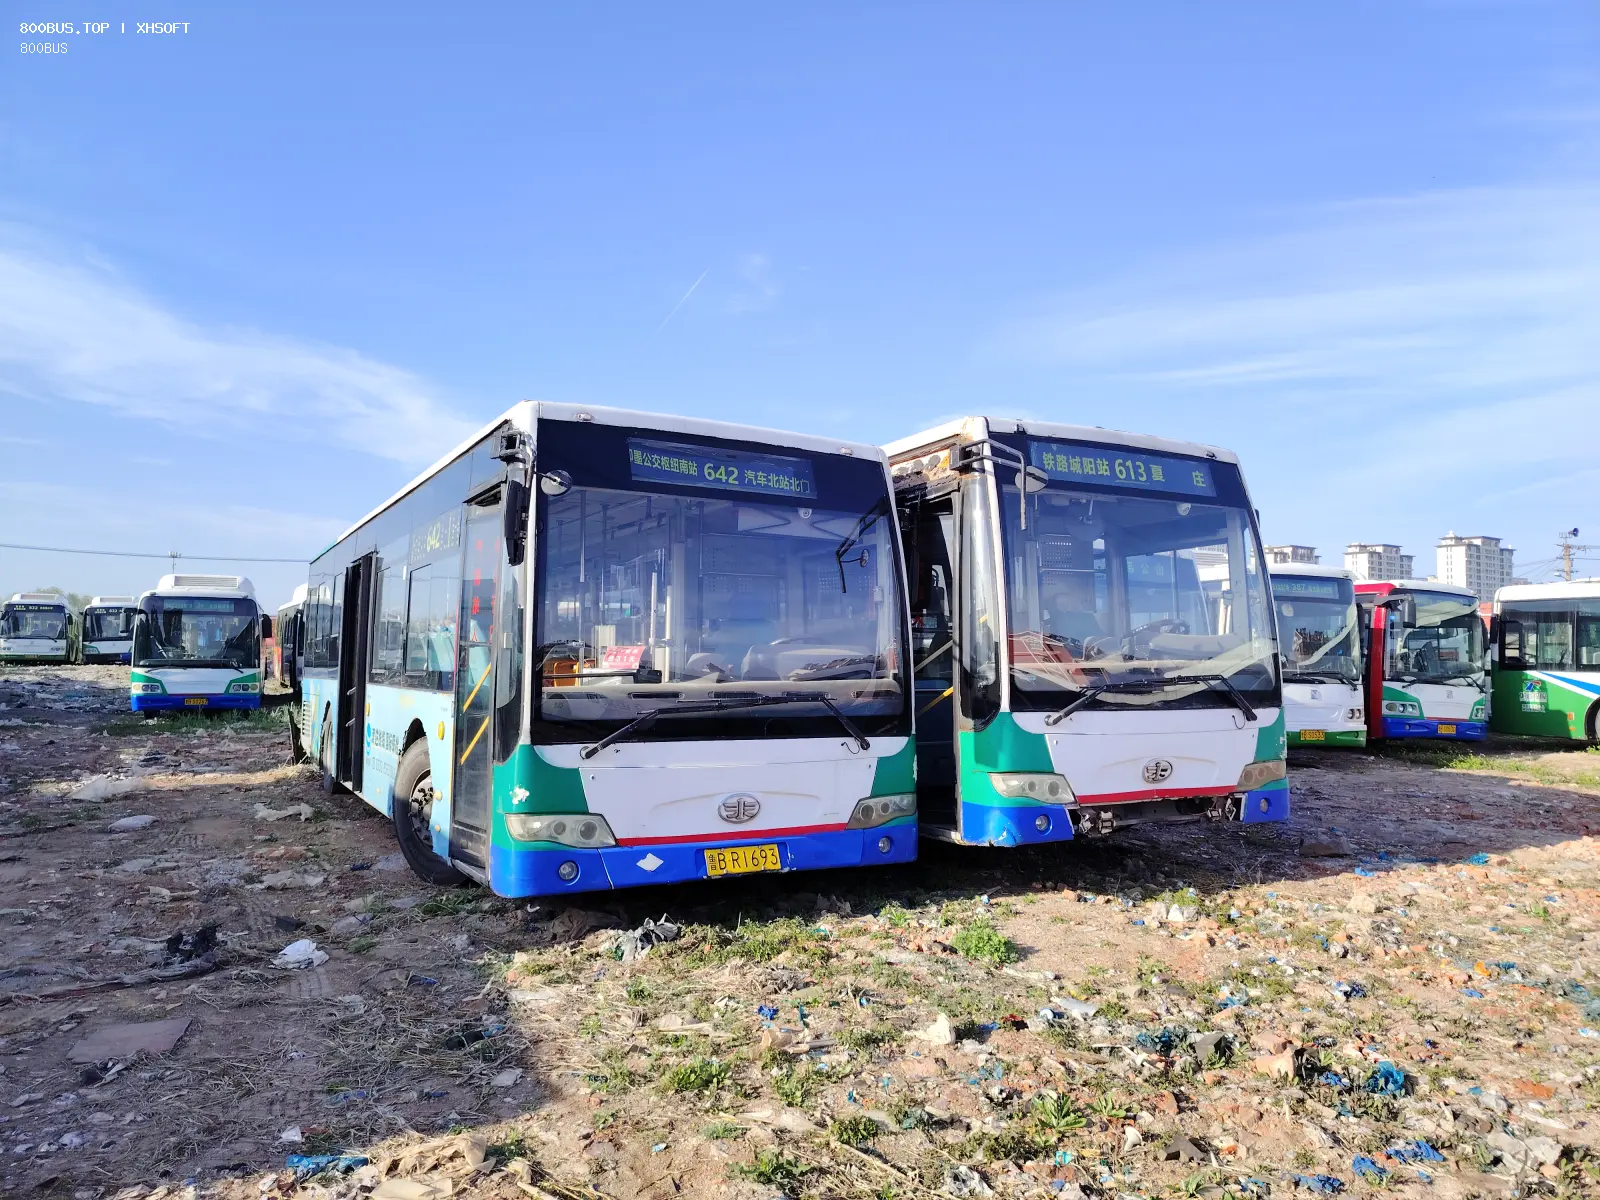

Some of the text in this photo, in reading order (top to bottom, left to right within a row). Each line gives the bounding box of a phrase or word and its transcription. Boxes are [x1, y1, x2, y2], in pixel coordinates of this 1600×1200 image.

[703, 462, 739, 485] 642
[1042, 451, 1111, 477] 铁路城阳站
[1114, 458, 1148, 482] 613
